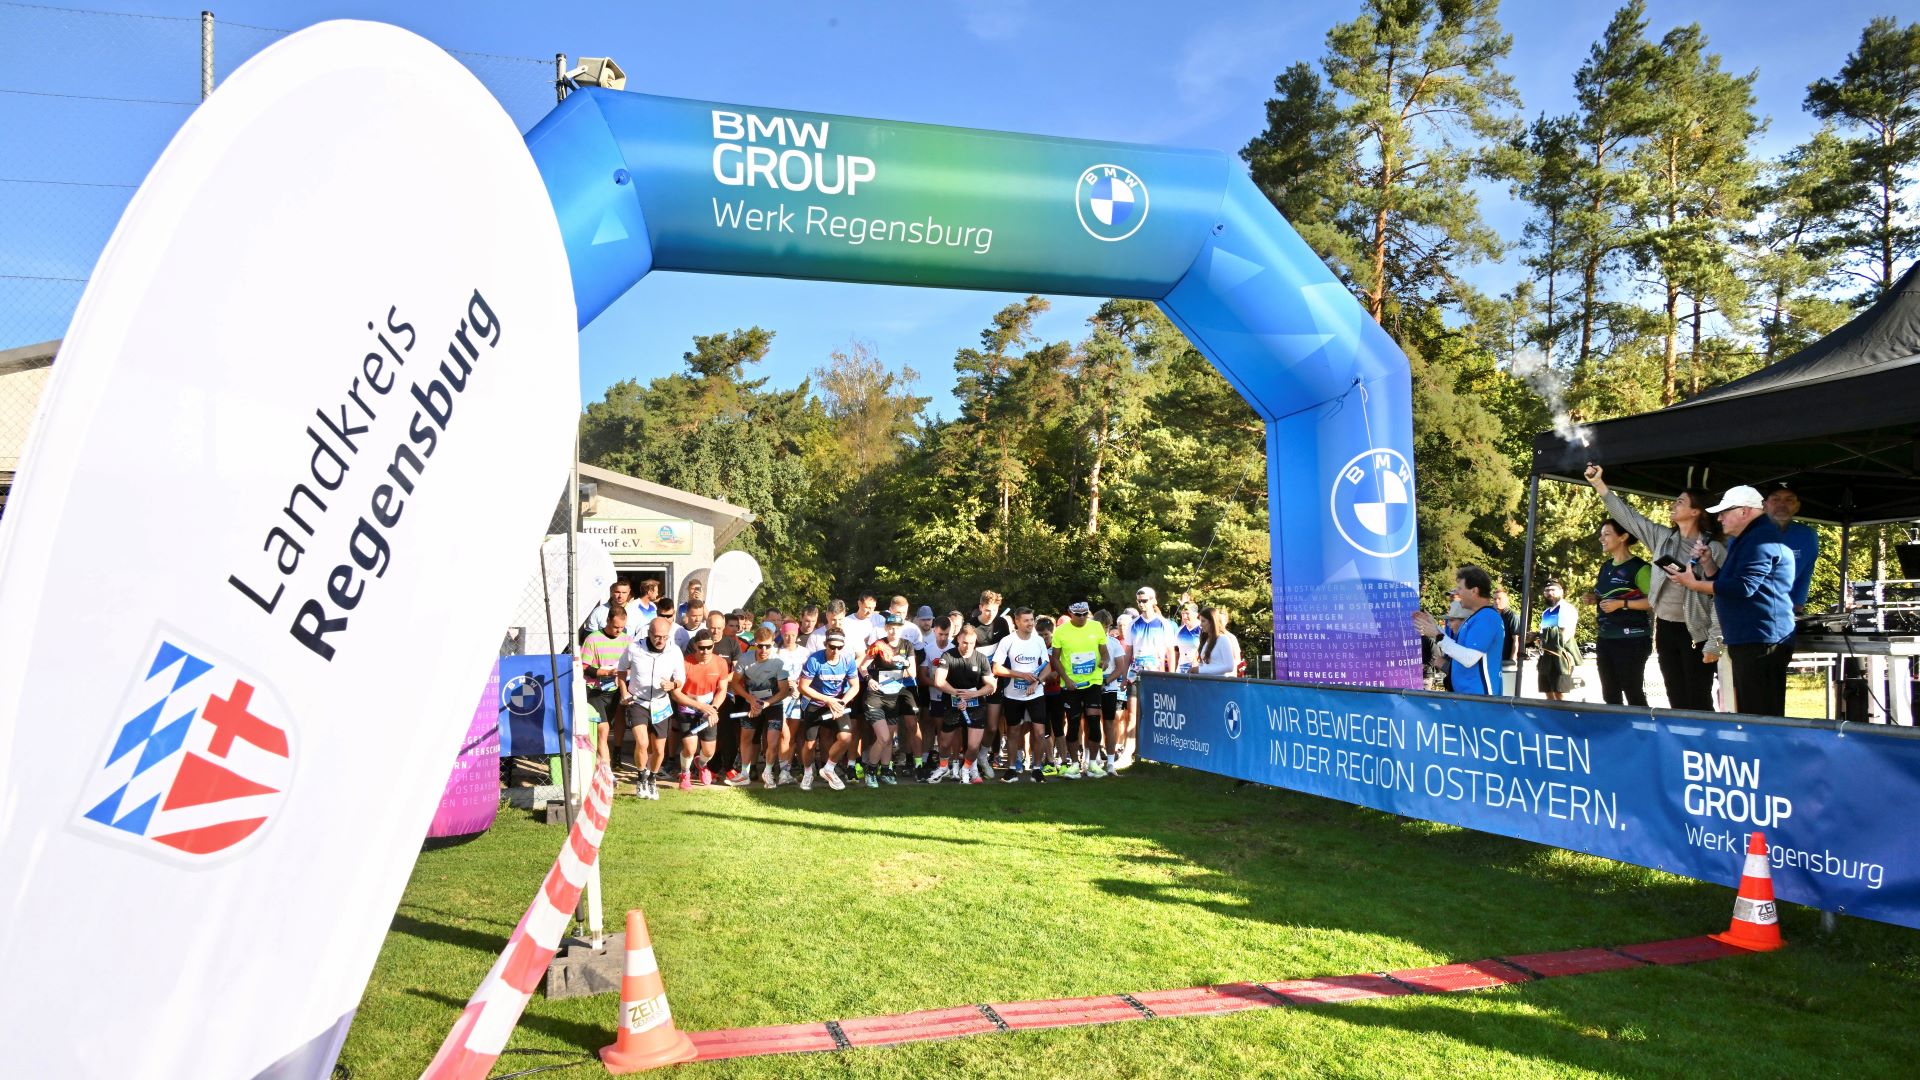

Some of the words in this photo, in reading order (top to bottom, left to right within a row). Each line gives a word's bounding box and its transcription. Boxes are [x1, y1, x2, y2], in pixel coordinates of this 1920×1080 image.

[711, 110, 829, 149] BMW
[712, 143, 876, 196] GROUP
[1085, 167, 1138, 189] BMW
[712, 197, 794, 233] Werk
[805, 205, 993, 254] Regensburg
[228, 304, 416, 615] Landkreis
[1345, 454, 1410, 485] BMW
[289, 287, 501, 662] Regensburg
[582, 525, 618, 534] rttreff
[601, 539, 619, 548] hof
[1301, 613, 1343, 621] BEWEGEN
[1305, 623, 1321, 631] DIE
[1327, 622, 1382, 631] MENSCHEN
[1288, 670, 1301, 678] WIR
[1303, 671, 1346, 679] BEWEGEN
[1326, 661, 1381, 669] MENSCHEN
[1153, 692, 1176, 711] BMW
[1153, 710, 1186, 730] GROUP
[1153, 731, 1170, 746] Werk
[1170, 734, 1210, 756] Regensburg
[1266, 704, 1302, 737] WIR
[1306, 708, 1406, 750] BEWEGEN
[1416, 720, 1591, 775] MENSCHEN
[1682, 750, 1760, 790] BMW
[1269, 739, 1287, 767] IN
[1293, 741, 1330, 776] DER
[1335, 746, 1415, 794] REGION
[1424, 763, 1627, 832] OSTBAYERN.
[1684, 783, 1792, 829] GROUP
[1685, 822, 1737, 854] Werk
[1755, 901, 1776, 916] ZEI
[628, 996, 660, 1022] ZEIT
